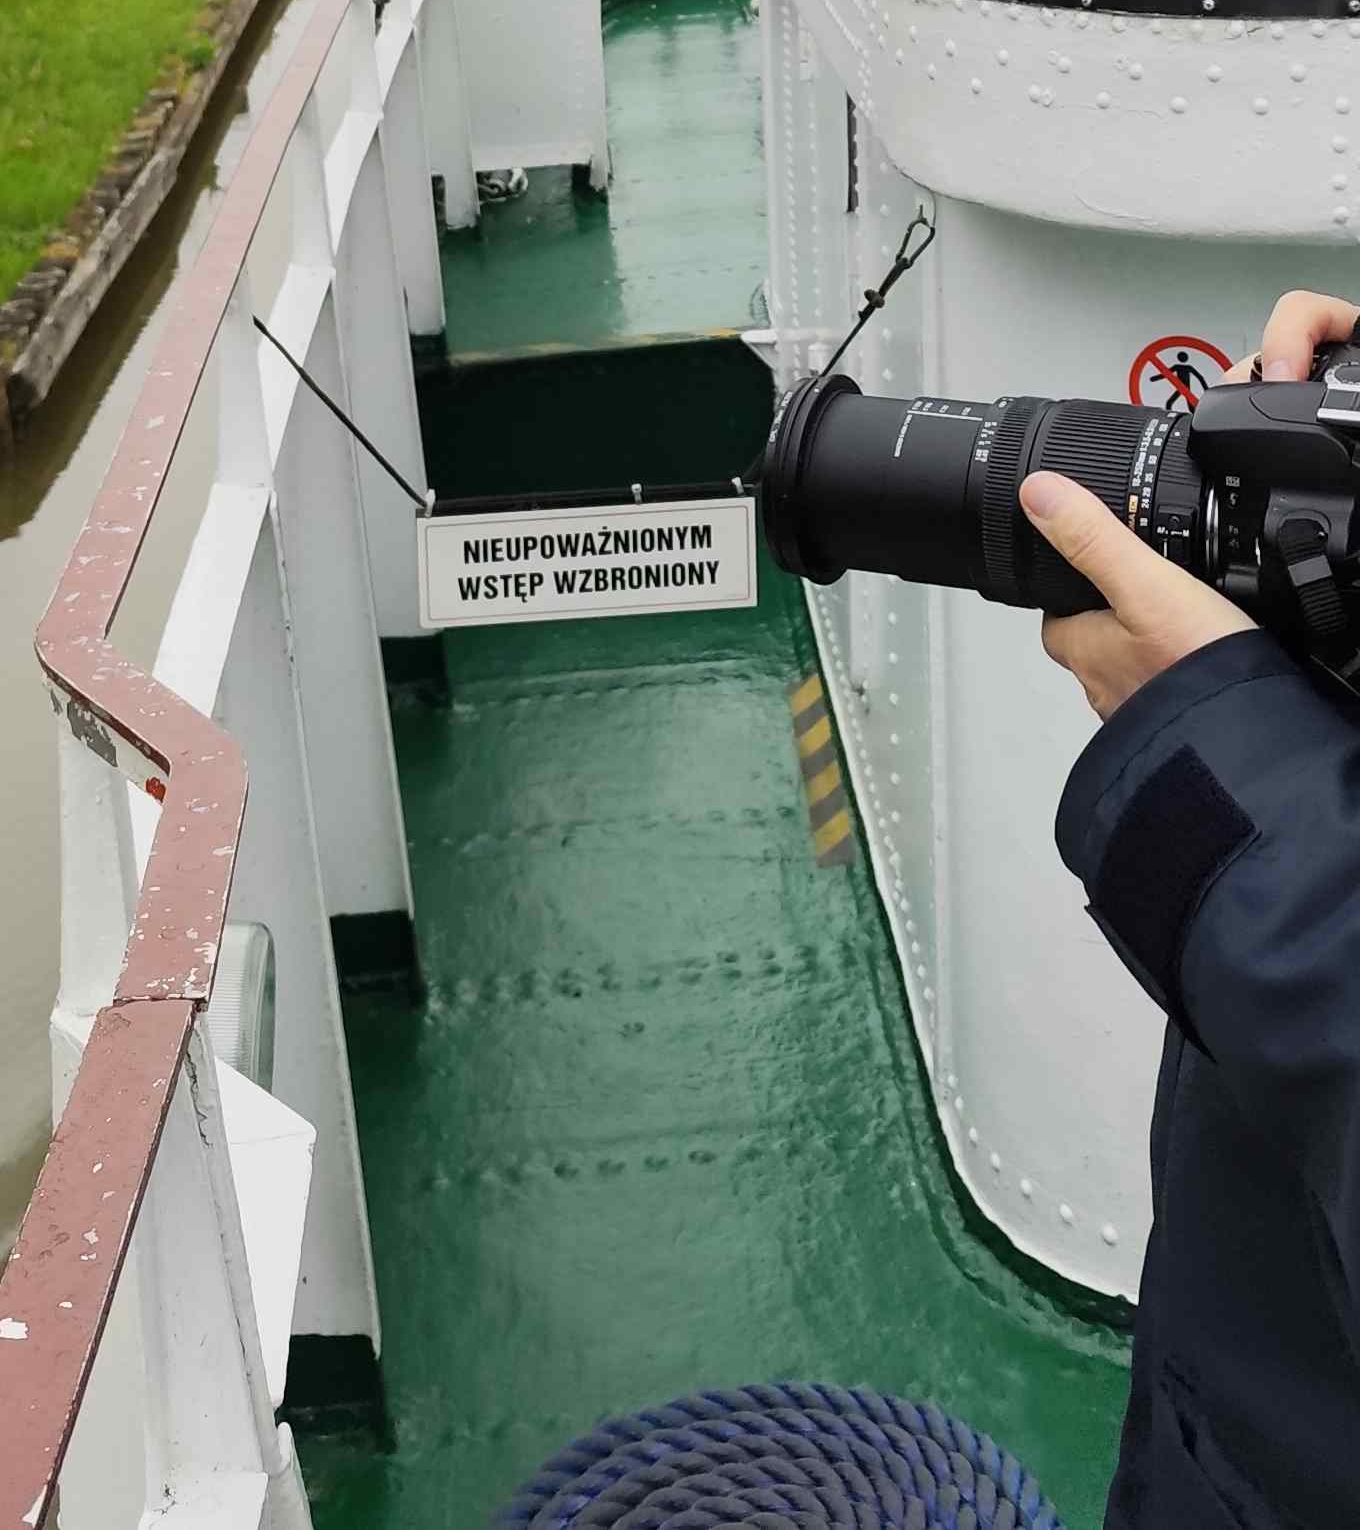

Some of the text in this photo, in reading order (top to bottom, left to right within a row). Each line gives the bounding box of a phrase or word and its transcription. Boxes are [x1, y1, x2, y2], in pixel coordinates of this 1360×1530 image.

[463, 524, 712, 564] NIEUPOWAŻNIONYM
[458, 560, 720, 603] WSTĘP WZBRONIONY
